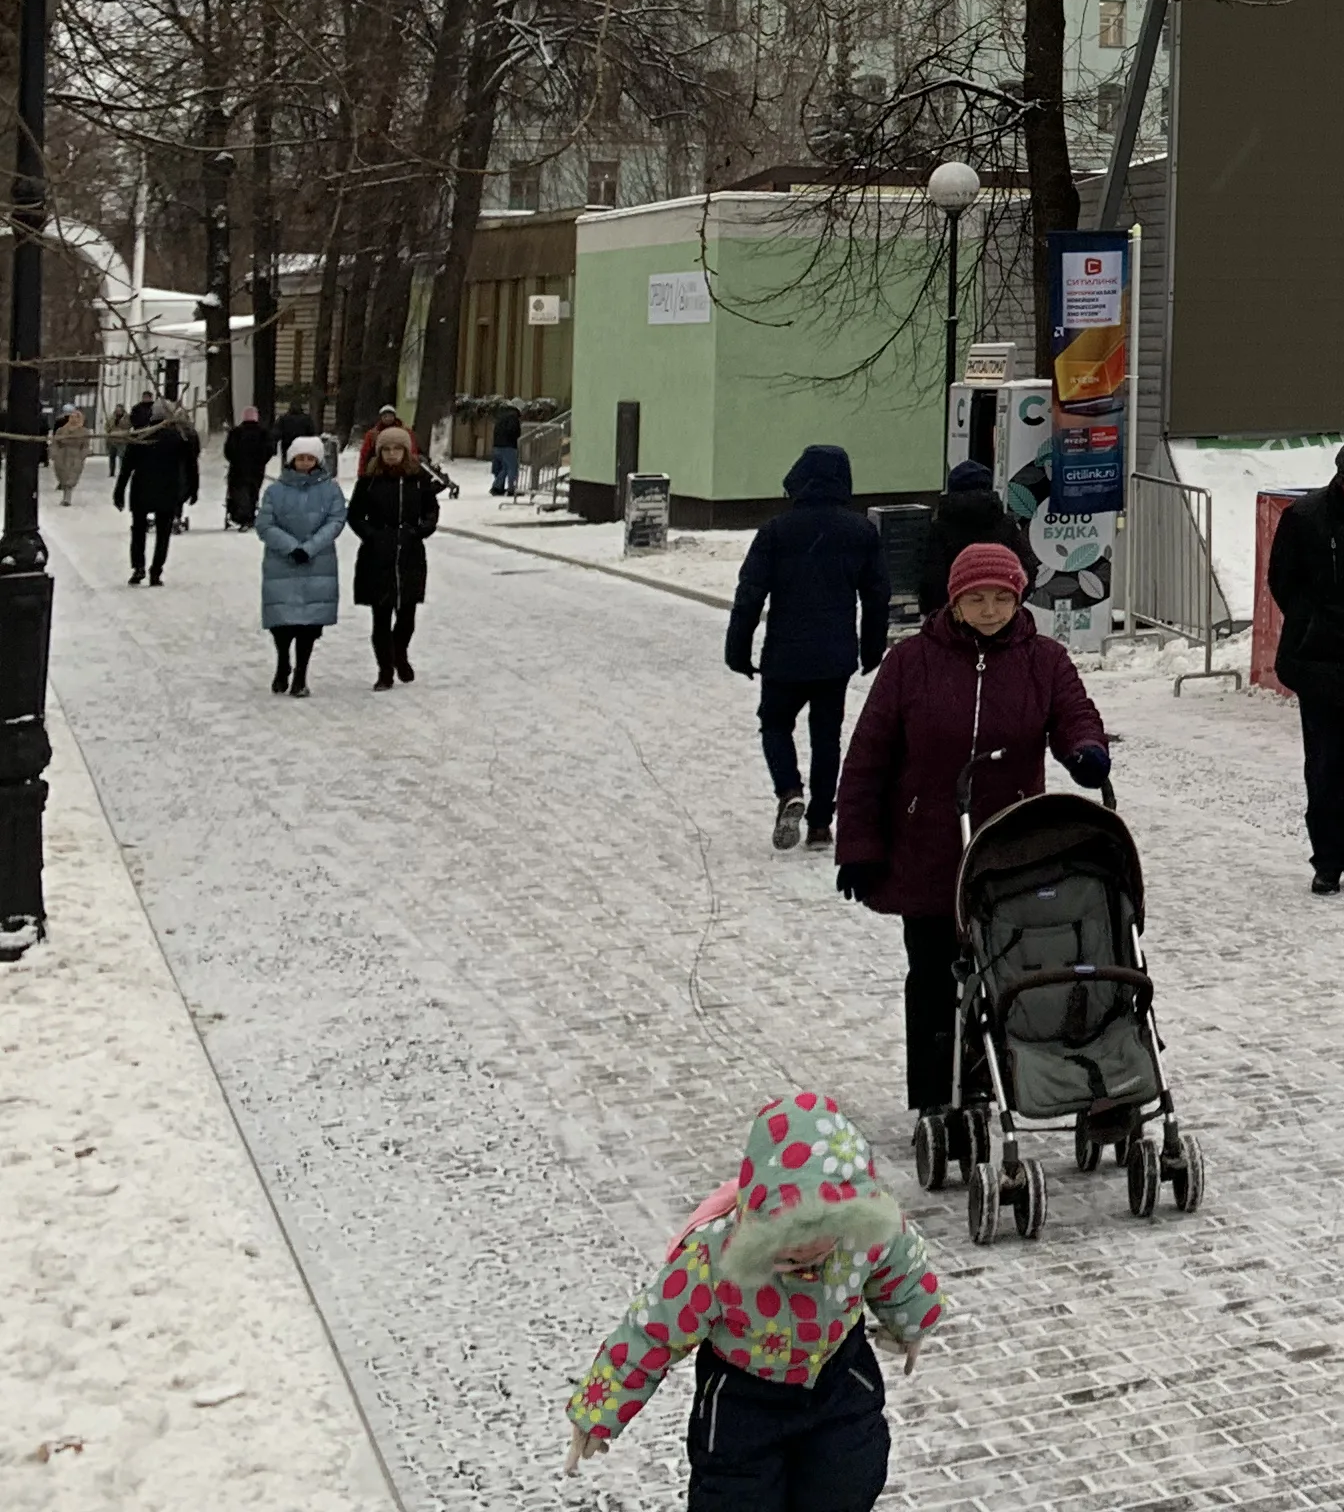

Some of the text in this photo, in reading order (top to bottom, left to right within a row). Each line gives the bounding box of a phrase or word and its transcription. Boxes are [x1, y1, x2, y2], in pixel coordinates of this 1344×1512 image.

[1067, 277, 1118, 286] СИТИЛИНК
[1066, 469, 1116, 481] citilink.ru
[1044, 514, 1092, 525] ФОТО
[1044, 525, 1098, 540] БУДКА
